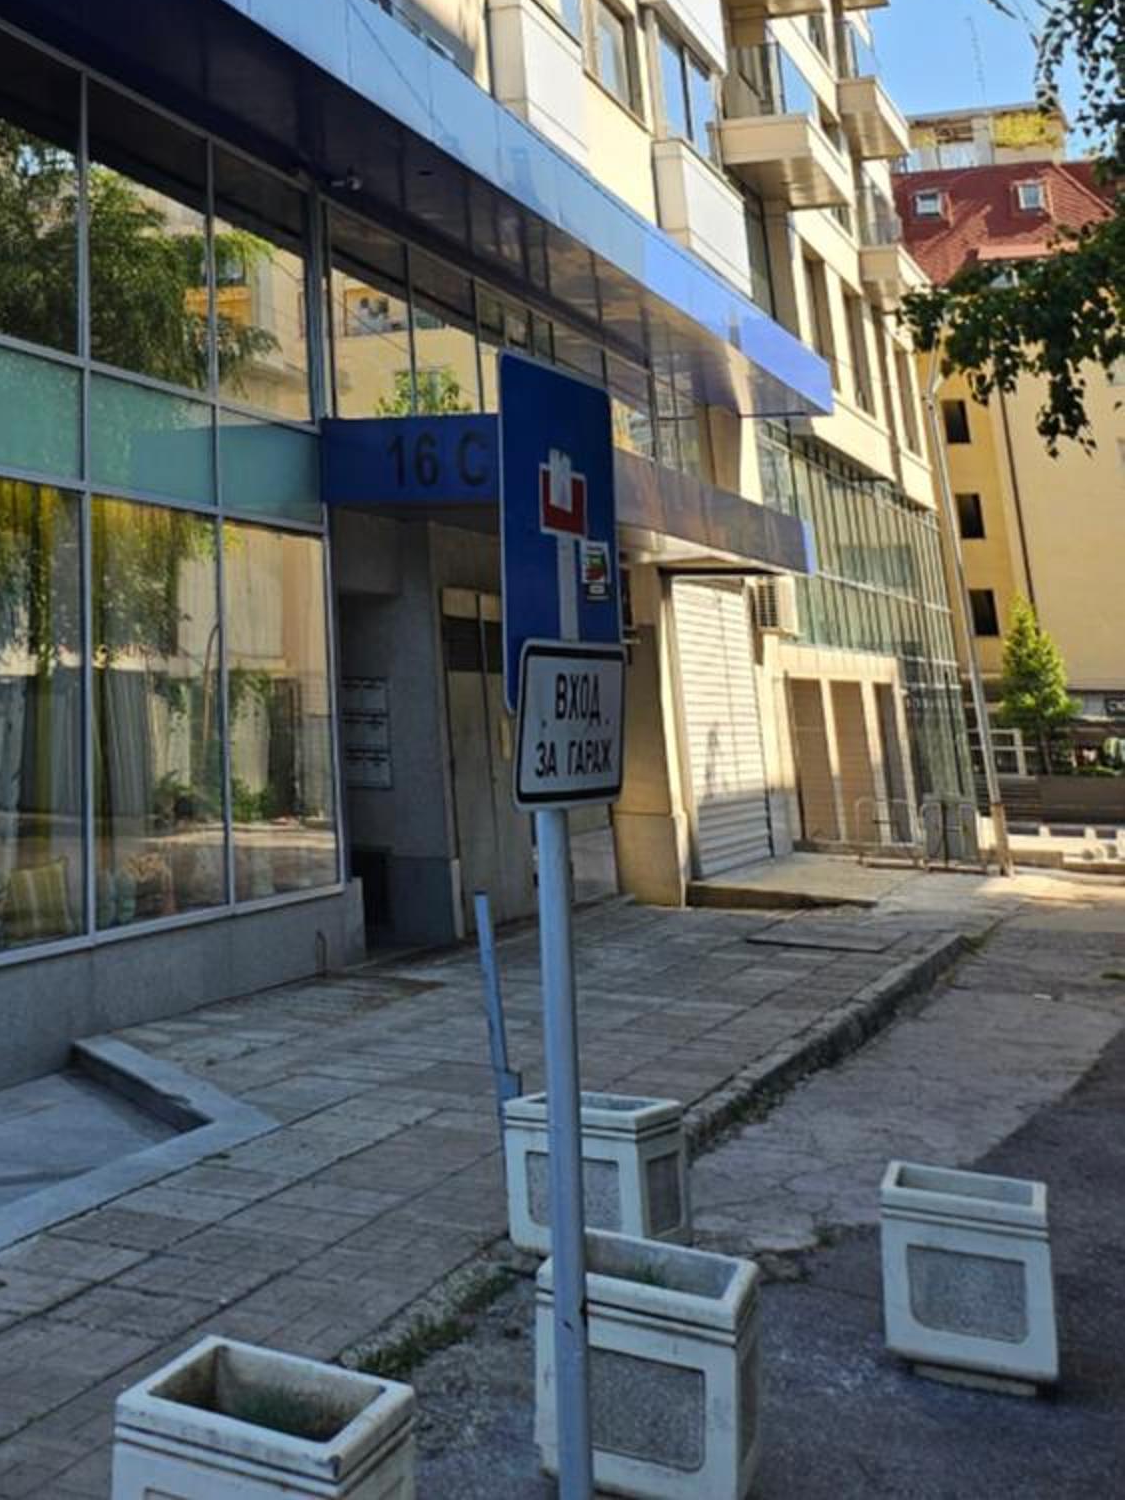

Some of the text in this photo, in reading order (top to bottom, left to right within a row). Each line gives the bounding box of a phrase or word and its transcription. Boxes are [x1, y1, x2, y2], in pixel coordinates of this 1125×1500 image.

[386, 431, 440, 488] 16
[556, 672, 601, 727] ВХОД
[535, 738, 613, 777] ЗА ГАРАЖ
